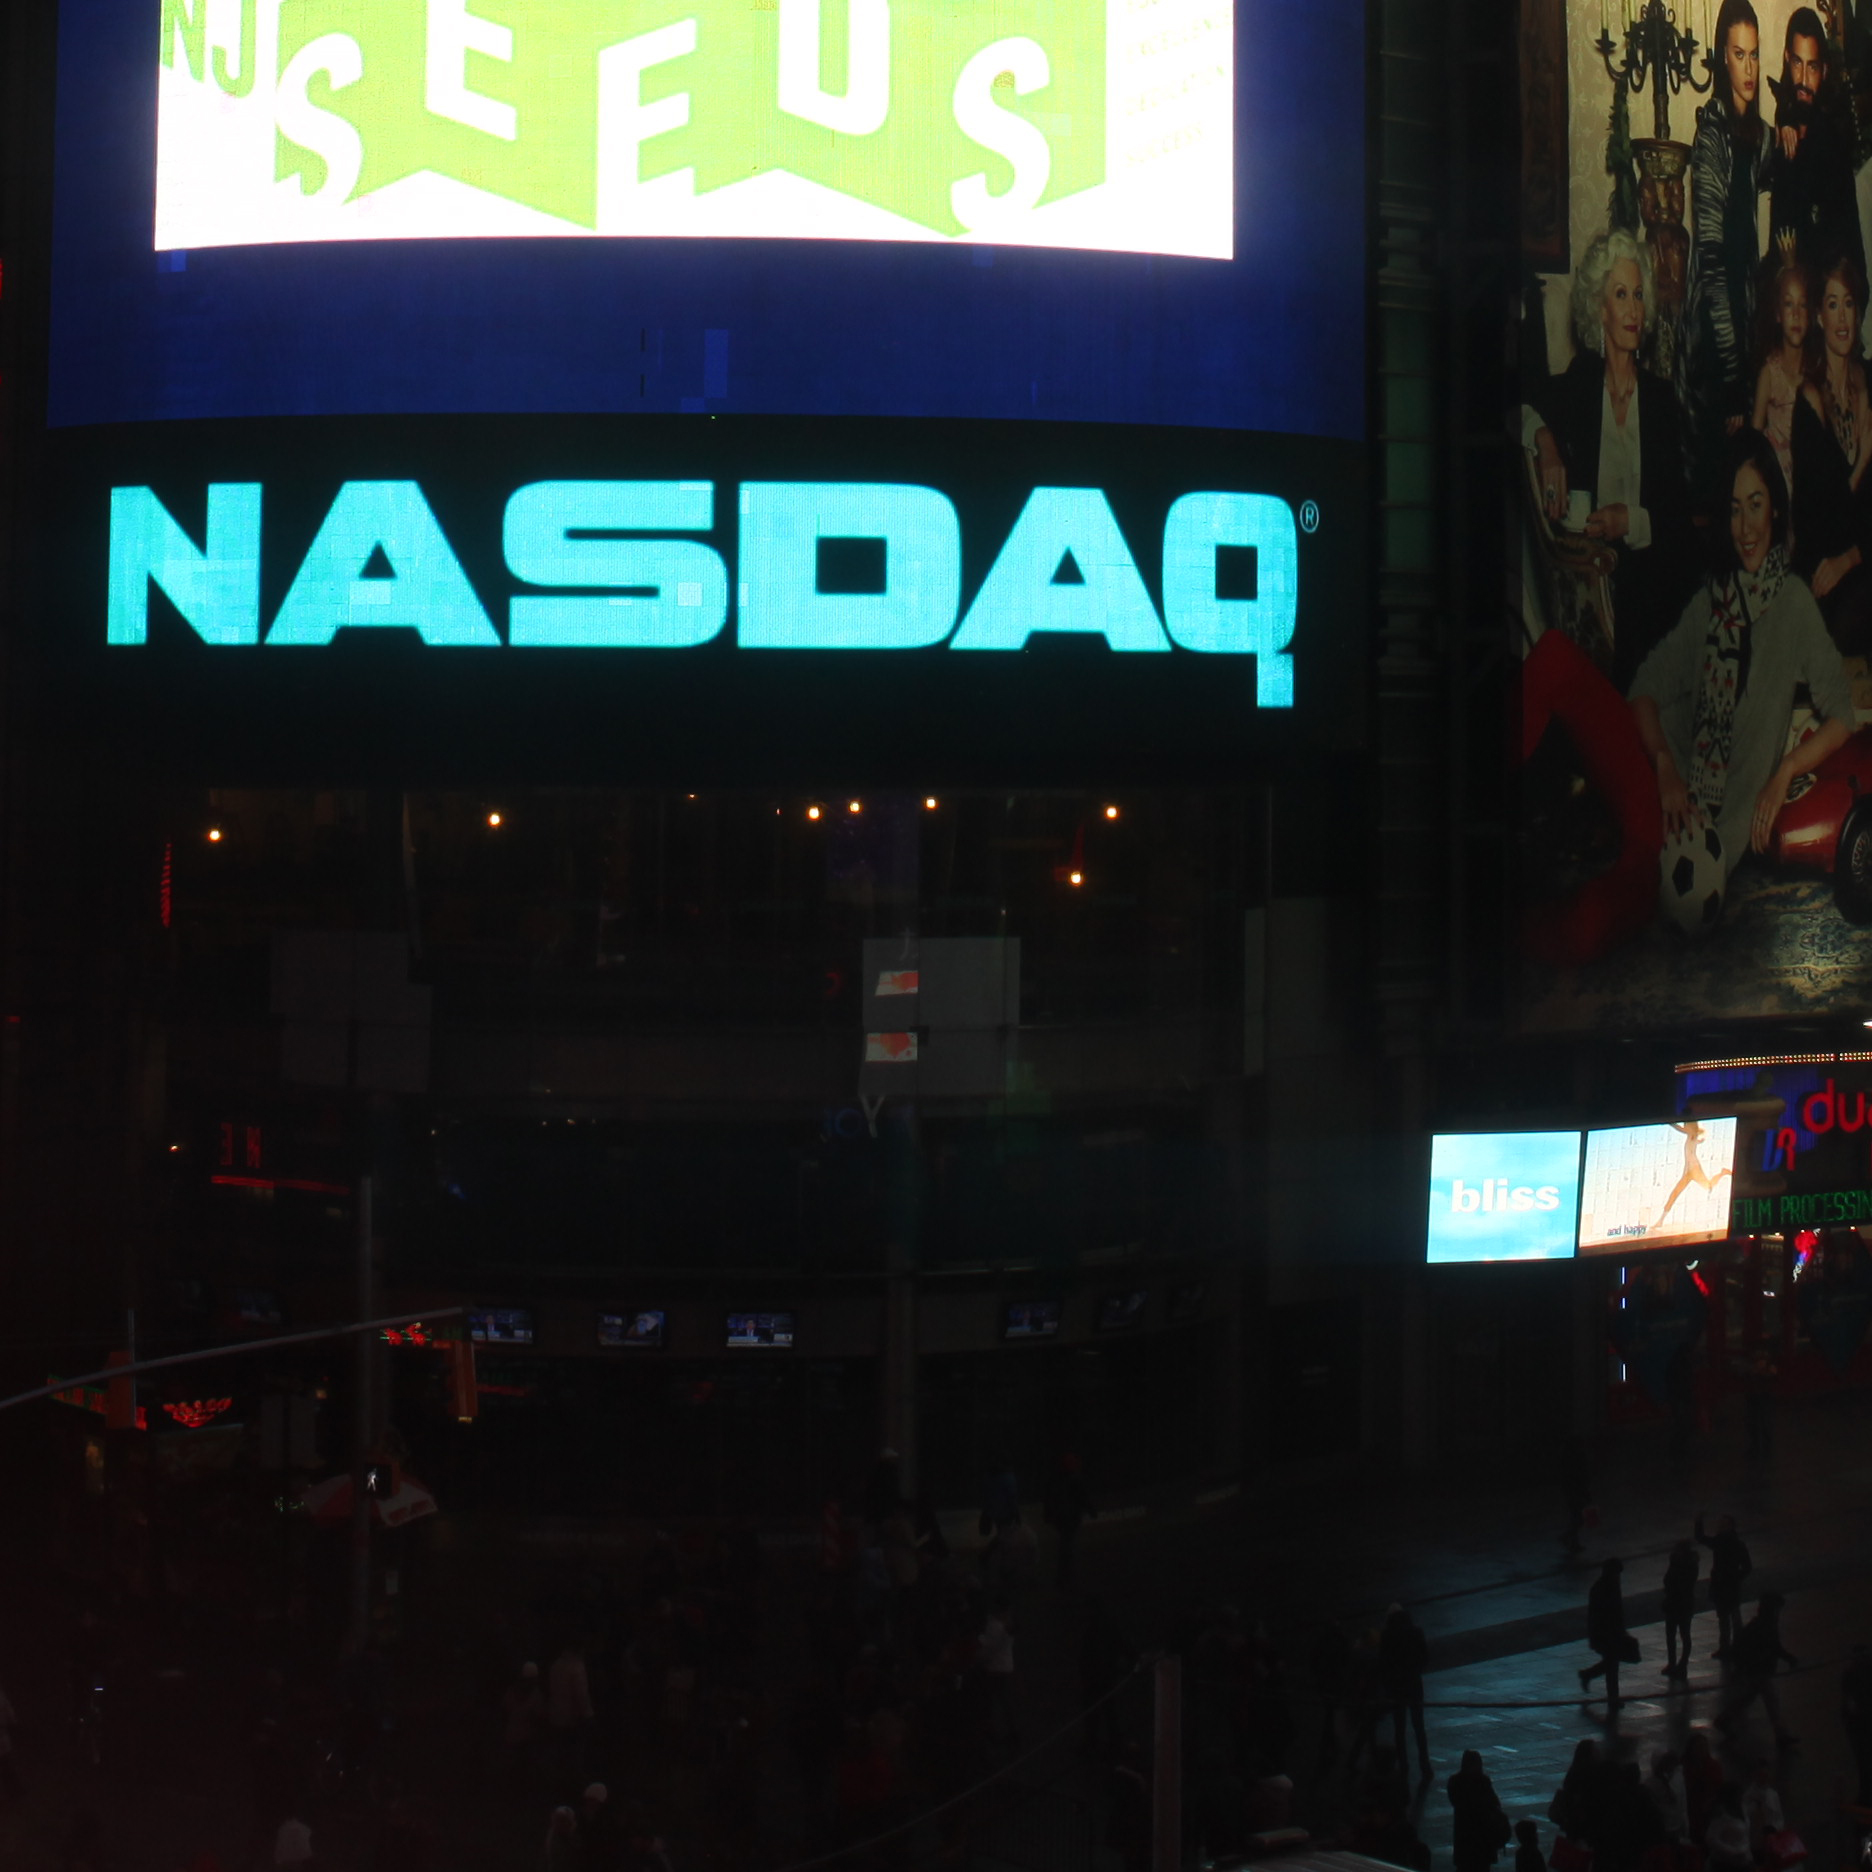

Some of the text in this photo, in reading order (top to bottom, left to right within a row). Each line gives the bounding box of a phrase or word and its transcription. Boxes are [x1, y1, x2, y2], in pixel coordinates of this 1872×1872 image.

[1451, 1179, 1560, 1212] bliss
[1733, 1198, 1773, 1228] FILM
[1607, 1223, 1647, 1237] and happy
